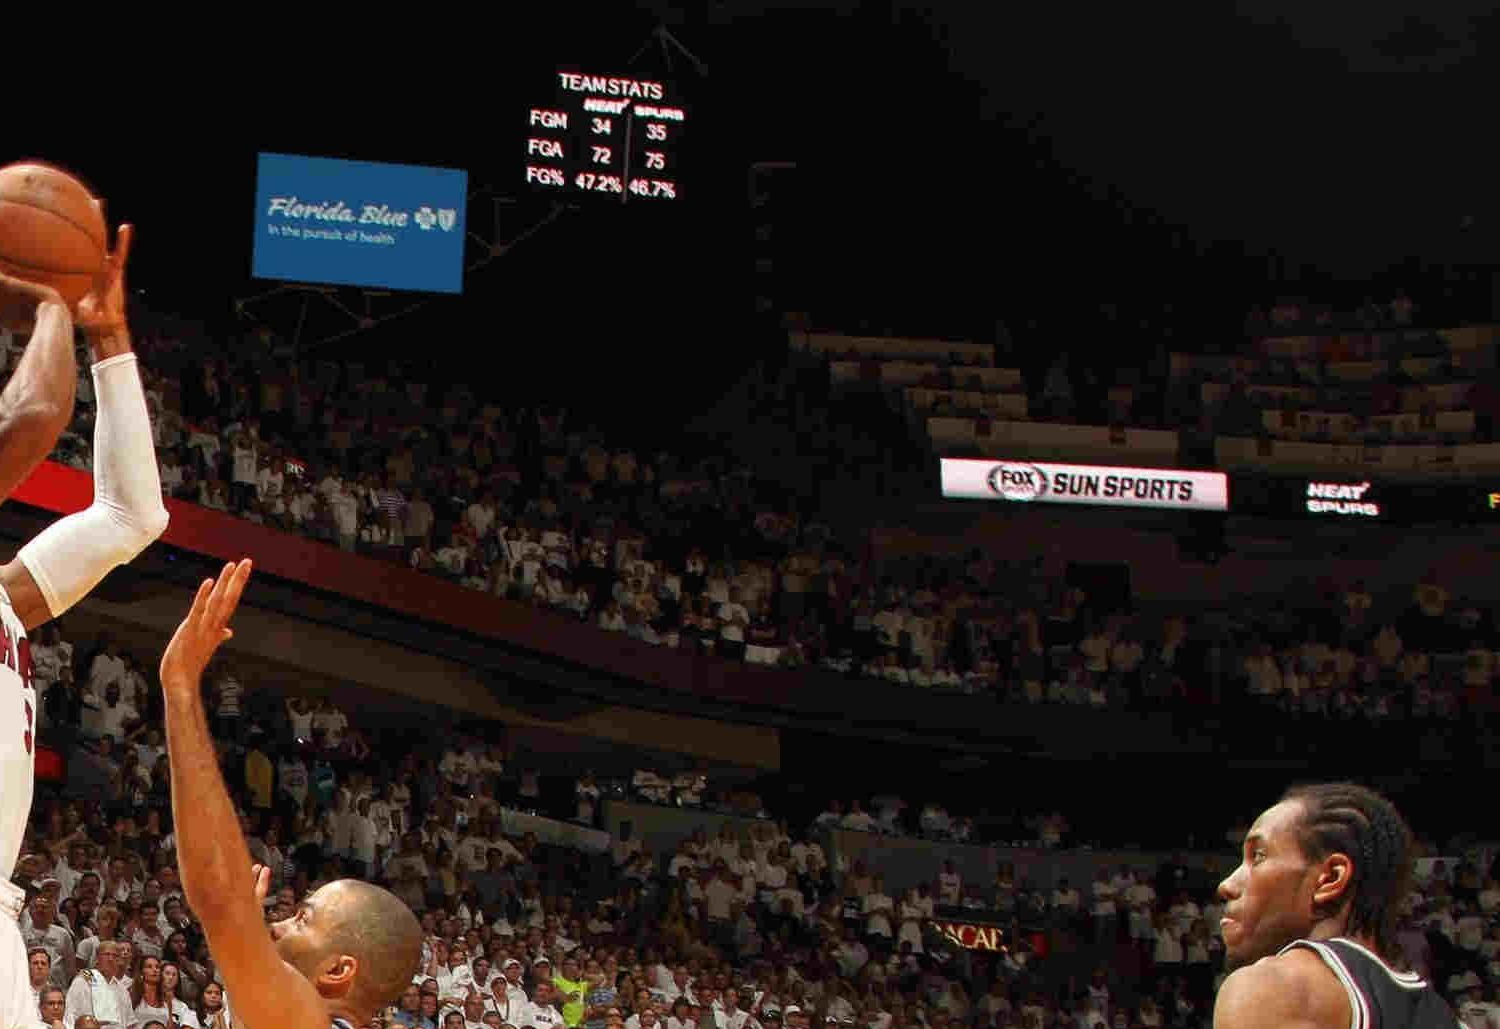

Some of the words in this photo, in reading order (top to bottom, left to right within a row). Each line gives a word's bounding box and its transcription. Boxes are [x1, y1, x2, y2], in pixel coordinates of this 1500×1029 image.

[558, 73, 606, 93] TEAM
[608, 79, 664, 100] STATS
[529, 108, 568, 130] FGM
[591, 117, 612, 136] 34
[646, 123, 667, 142] 35
[528, 138, 564, 159] FGA
[591, 146, 612, 165] 72
[645, 152, 665, 170] 75
[526, 166, 565, 187] FG%
[575, 173, 623, 193] 47.2%
[628, 178, 676, 199] 46.7%
[267, 196, 356, 223] Florida
[358, 204, 409, 227] Blue
[1001, 470, 1035, 486] FOX
[1053, 473, 1099, 497] SUN
[1103, 475, 1193, 502] SPORTS
[1307, 482, 1371, 500] HEAT
[1307, 499, 1380, 516] SPURS
